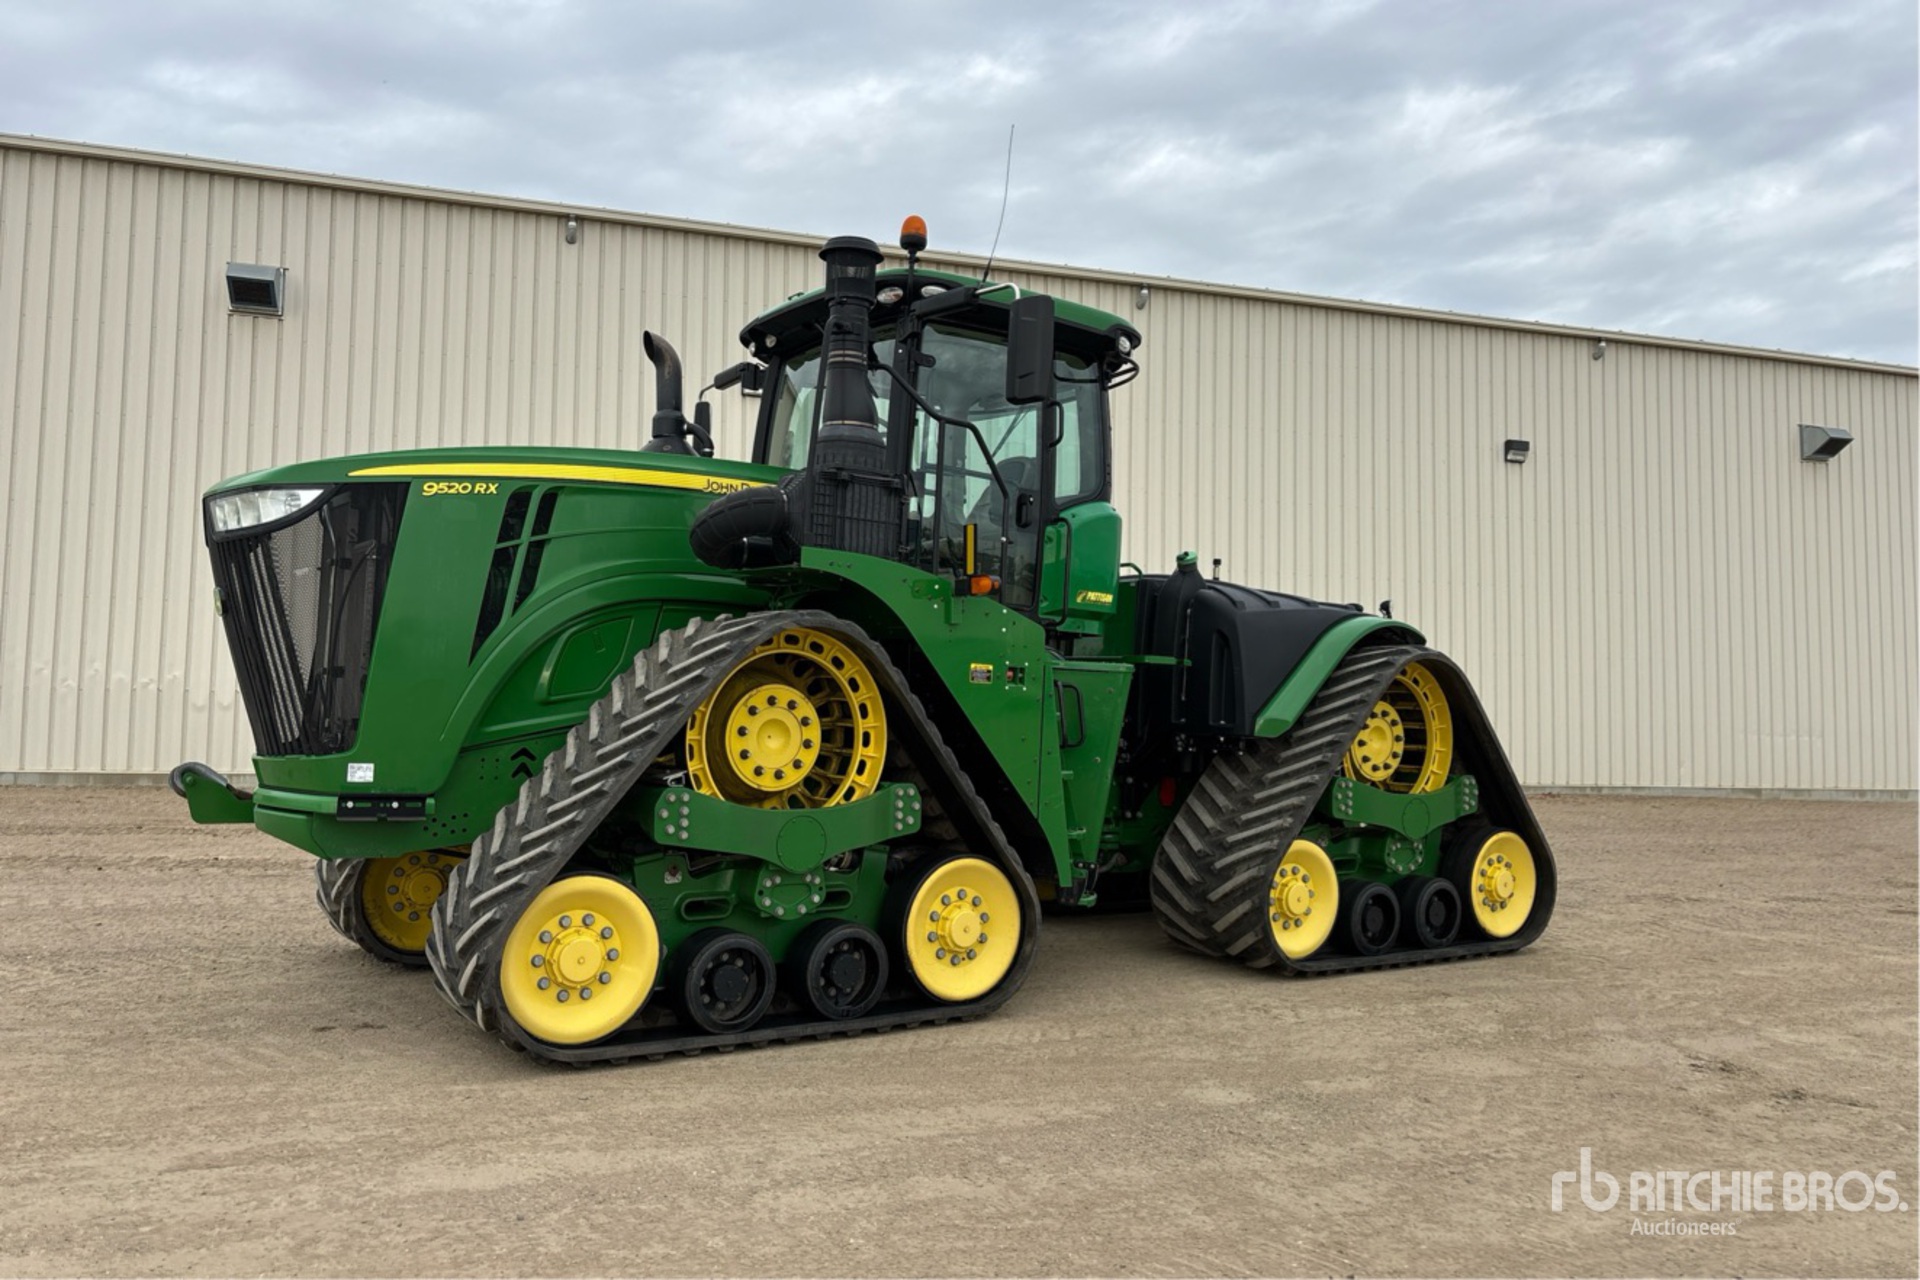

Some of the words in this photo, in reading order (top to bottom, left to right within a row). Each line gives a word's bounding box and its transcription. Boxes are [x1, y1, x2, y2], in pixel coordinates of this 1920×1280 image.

[422, 482, 472, 496] 9520
[474, 482, 499, 494] RX
[703, 478, 738, 493] JOHN
